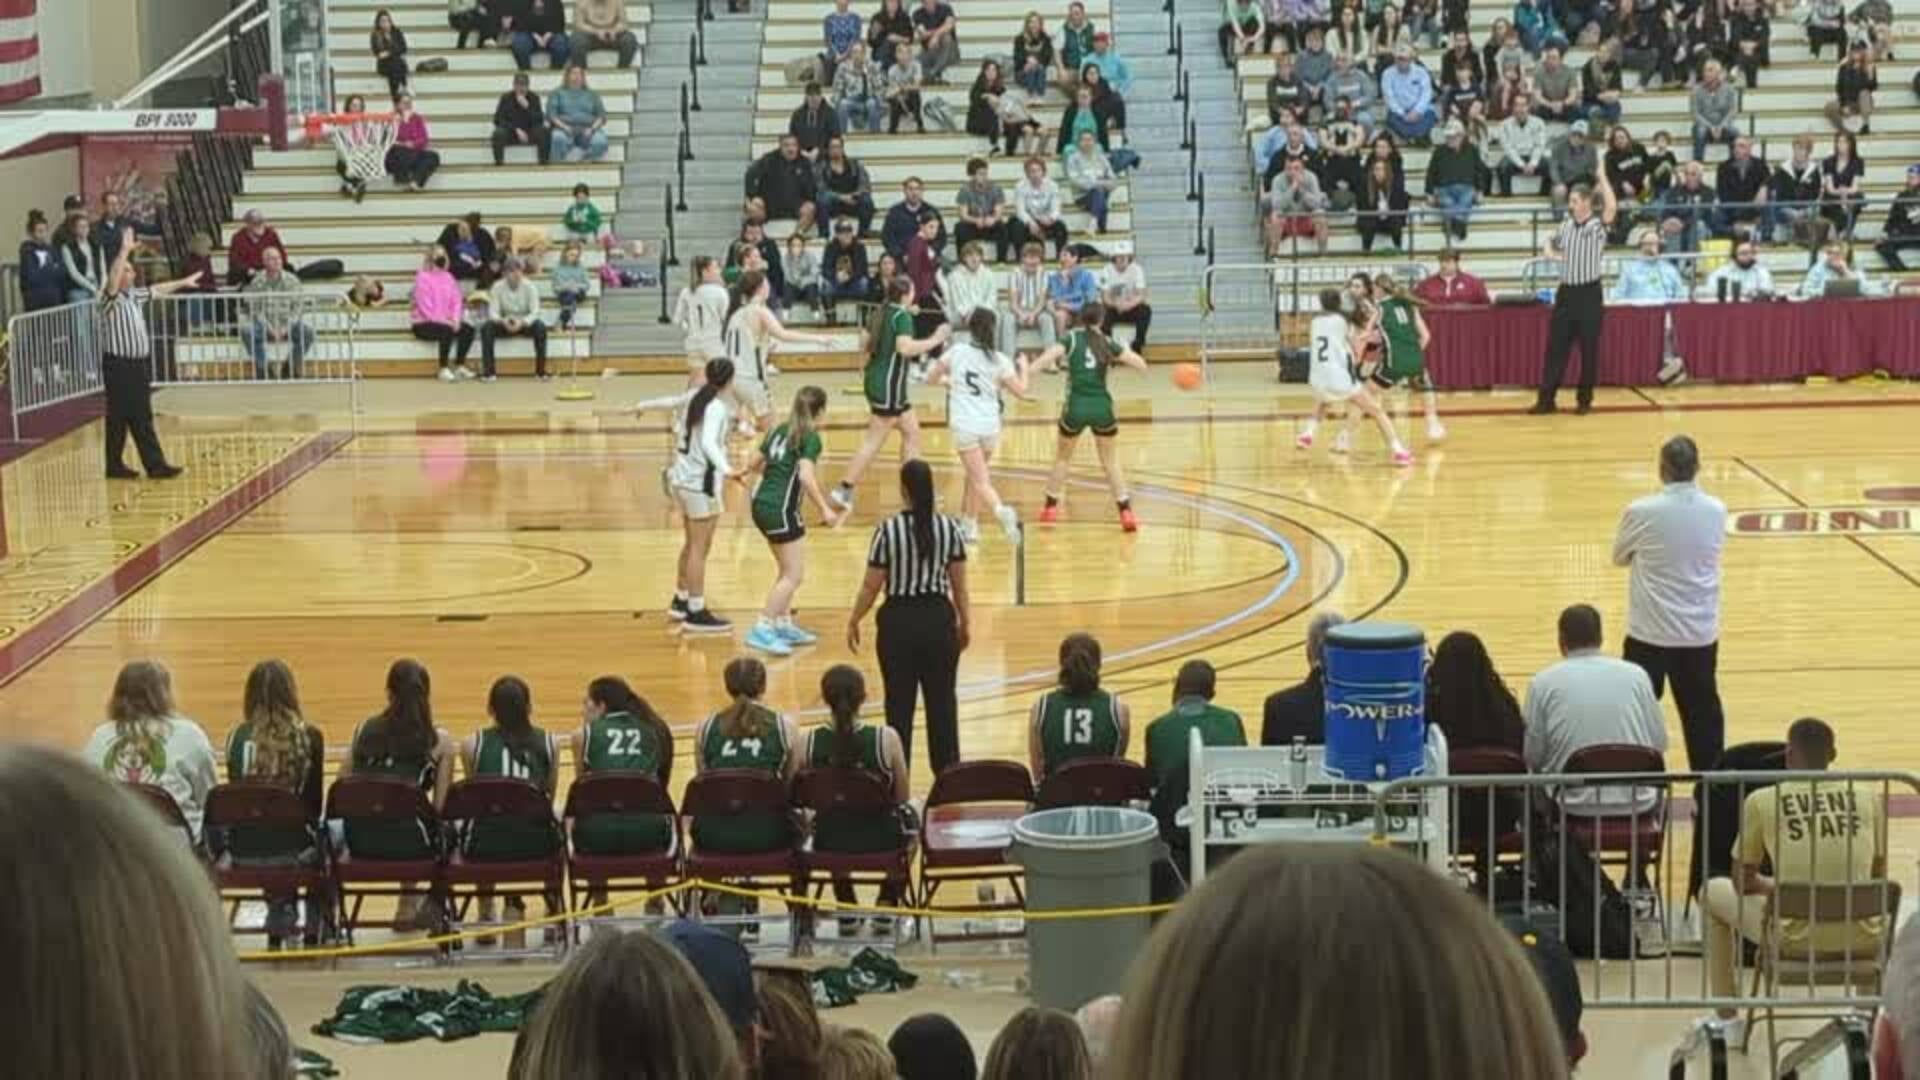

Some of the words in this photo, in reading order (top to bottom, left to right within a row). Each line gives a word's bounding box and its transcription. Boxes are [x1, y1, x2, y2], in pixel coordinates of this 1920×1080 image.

[1317, 336, 1329, 362] 2
[965, 370, 981, 396] 5
[1063, 707, 1093, 744] 13
[606, 728, 641, 755] 22
[1782, 790, 1858, 816] EVENT
[1787, 814, 1860, 841] STAFF
